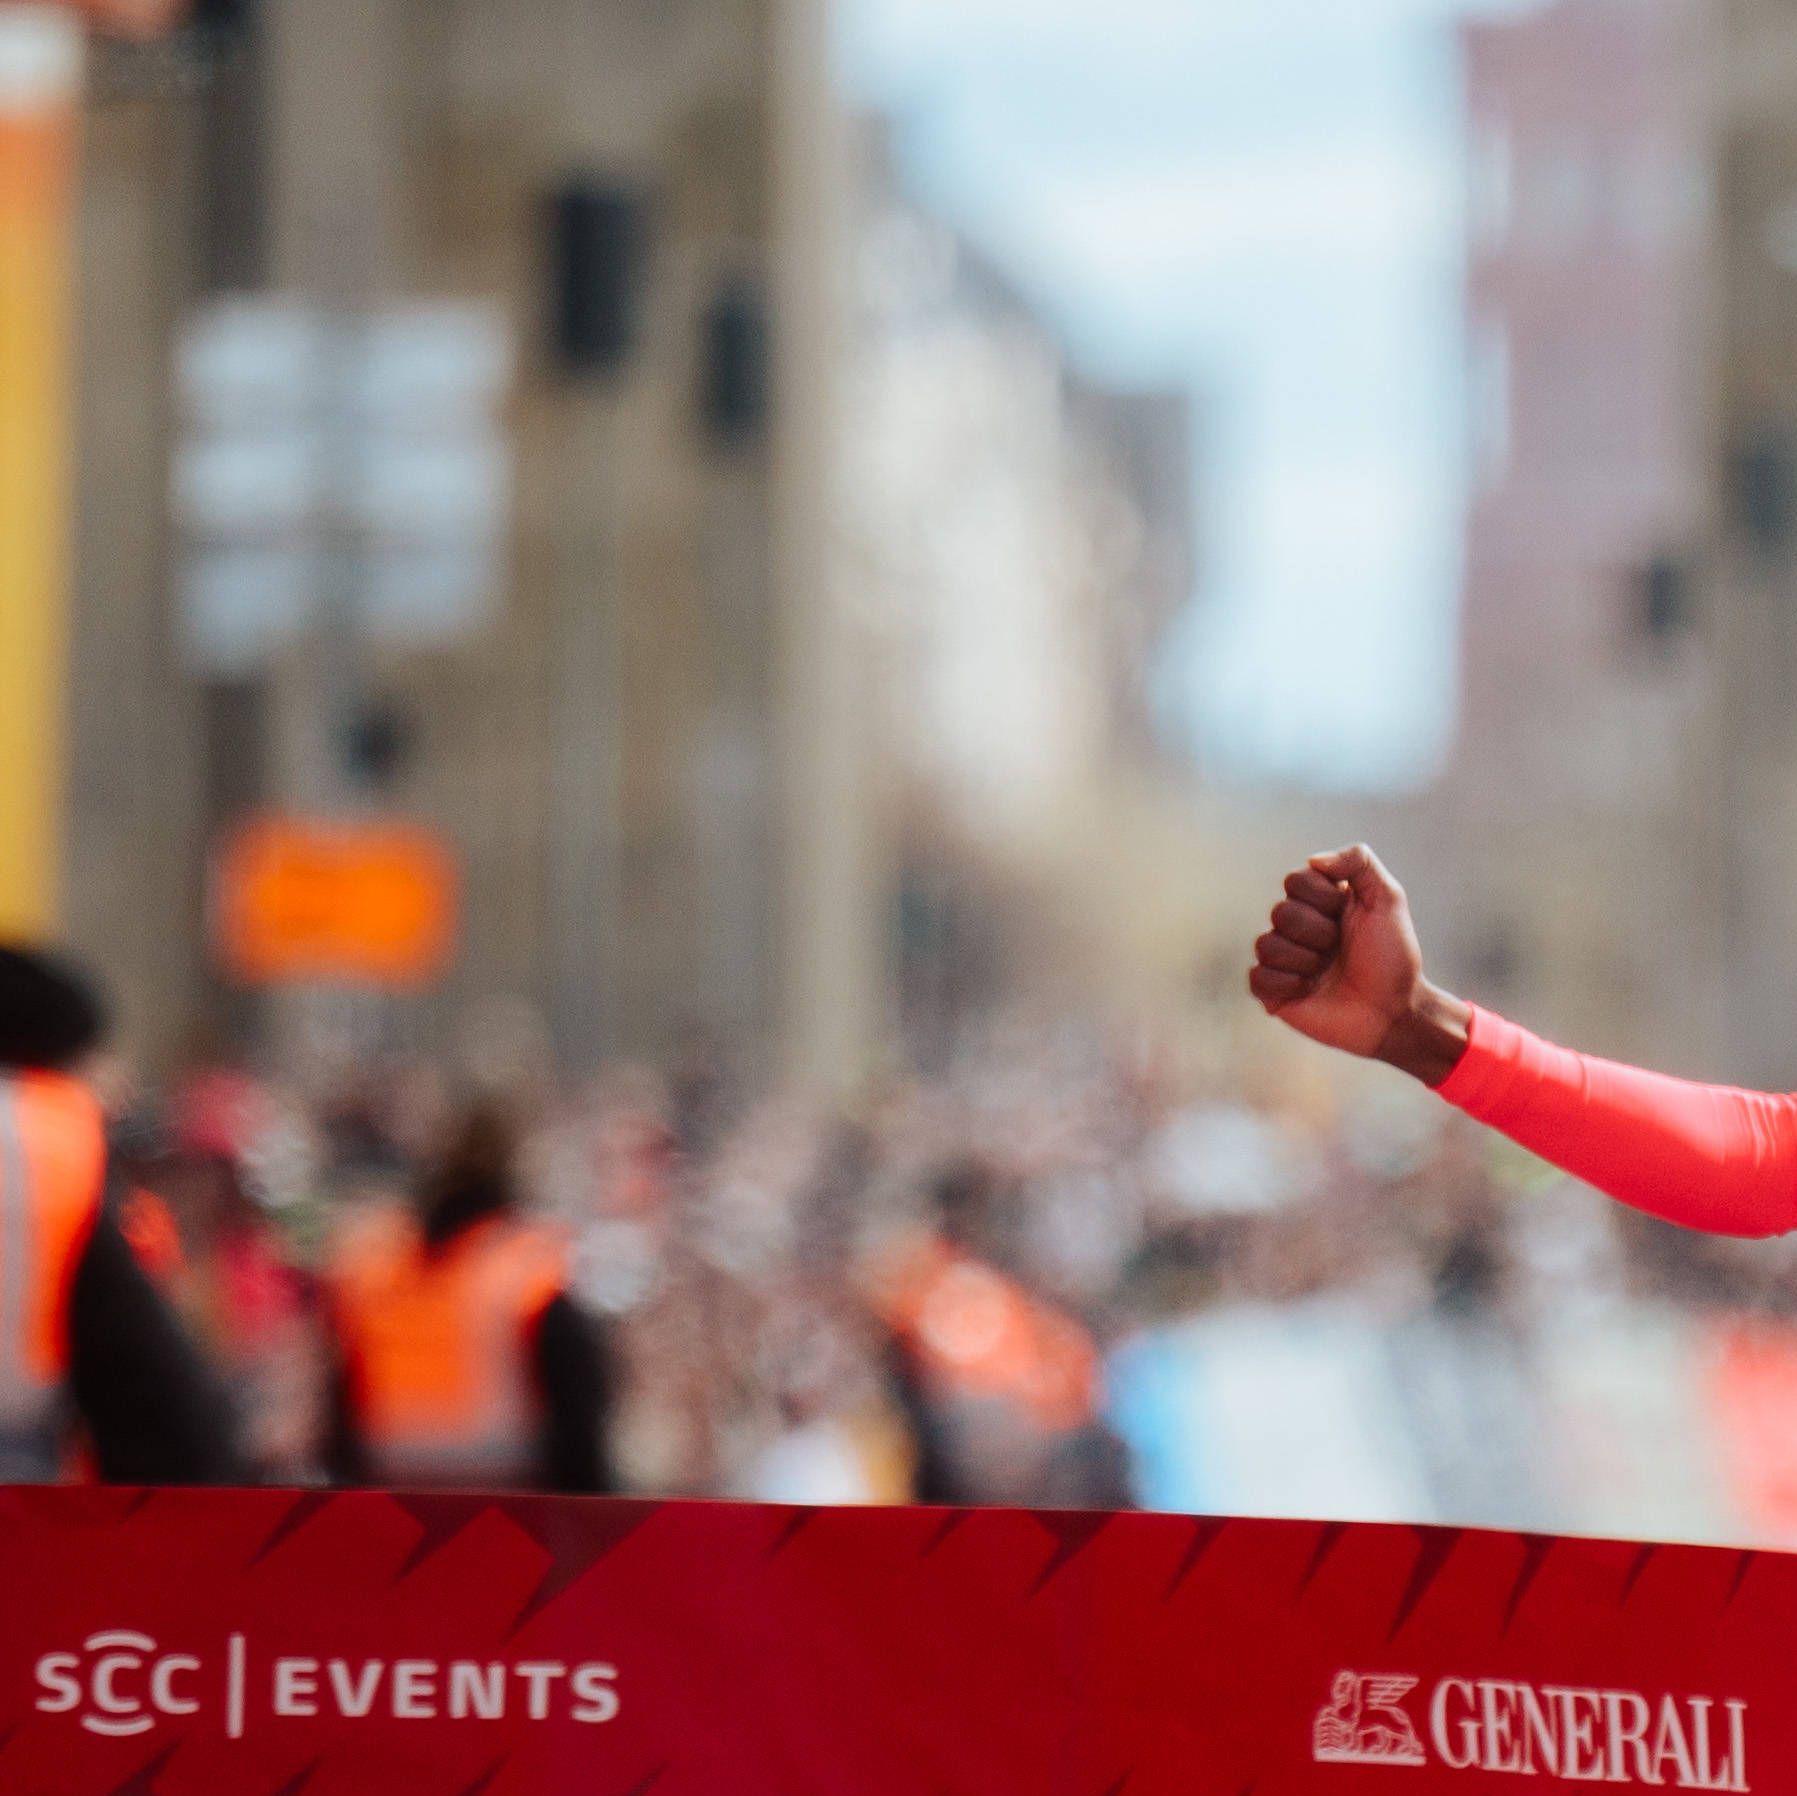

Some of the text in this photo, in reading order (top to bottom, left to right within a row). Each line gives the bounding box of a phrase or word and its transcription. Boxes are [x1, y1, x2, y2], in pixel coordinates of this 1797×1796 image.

[34, 1639, 620, 1728] SCC EVENTS
[1429, 1675, 1752, 1793] GENERALI
